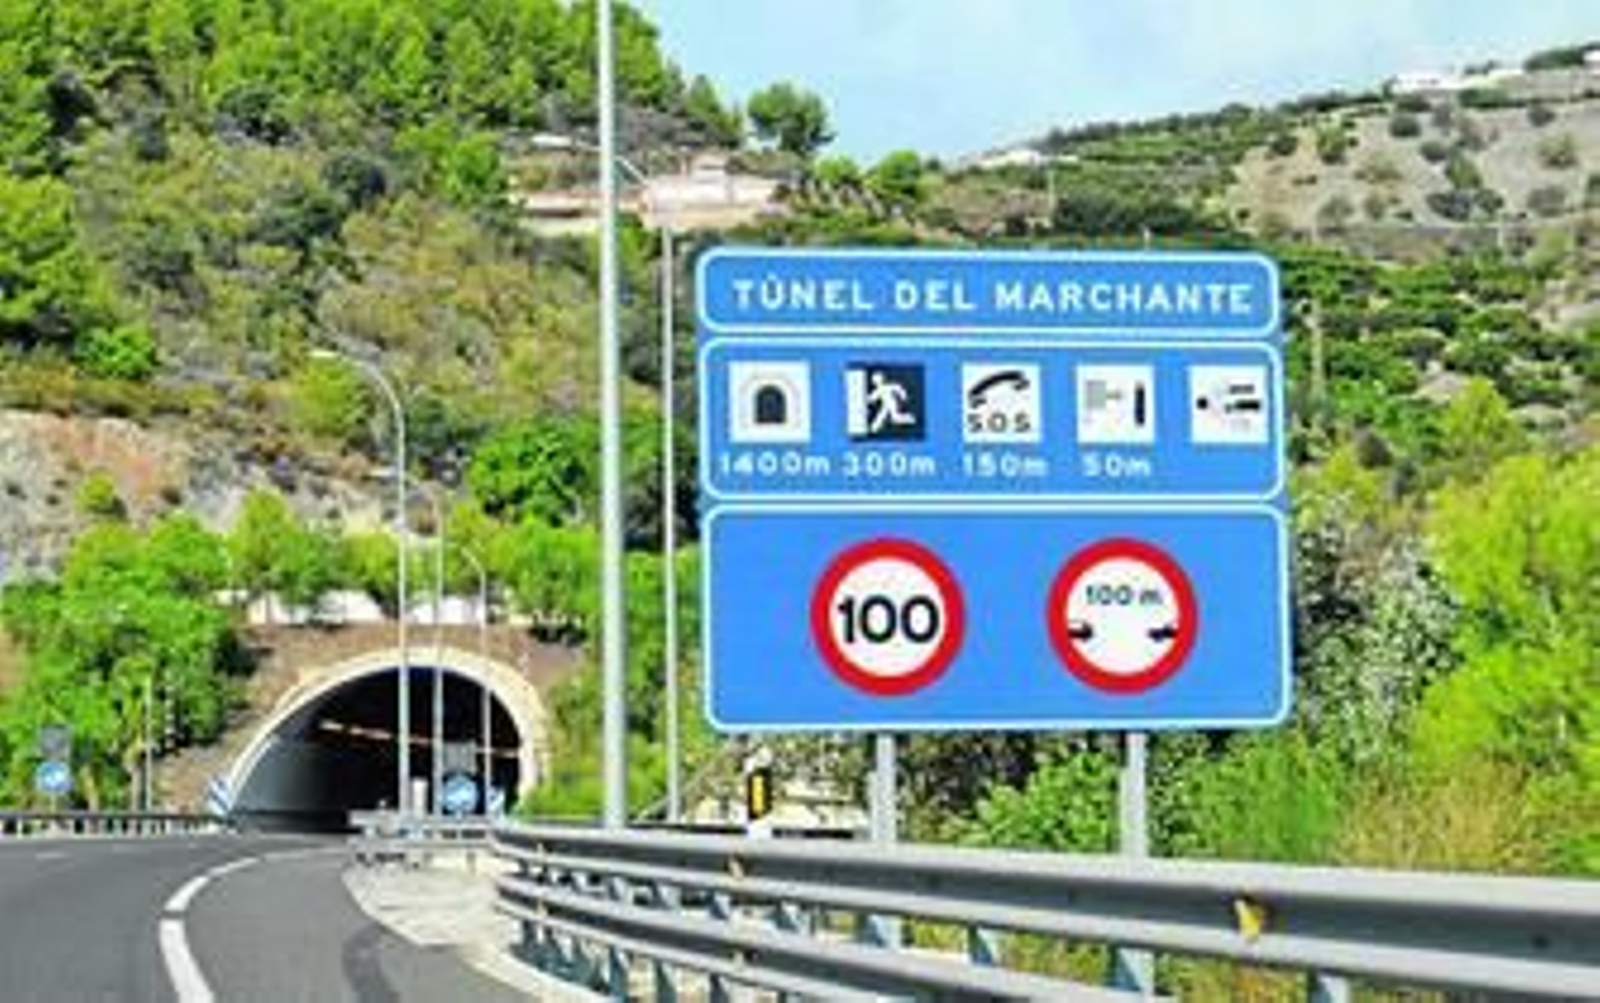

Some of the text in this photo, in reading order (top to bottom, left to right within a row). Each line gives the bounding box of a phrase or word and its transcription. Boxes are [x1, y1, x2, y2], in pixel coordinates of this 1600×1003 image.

[894, 281, 975, 311] DEL
[996, 282, 1253, 314] MARCHANTE
[720, 453, 1151, 478] 1400m 300m 150m 50m
[837, 595, 940, 644] 100
